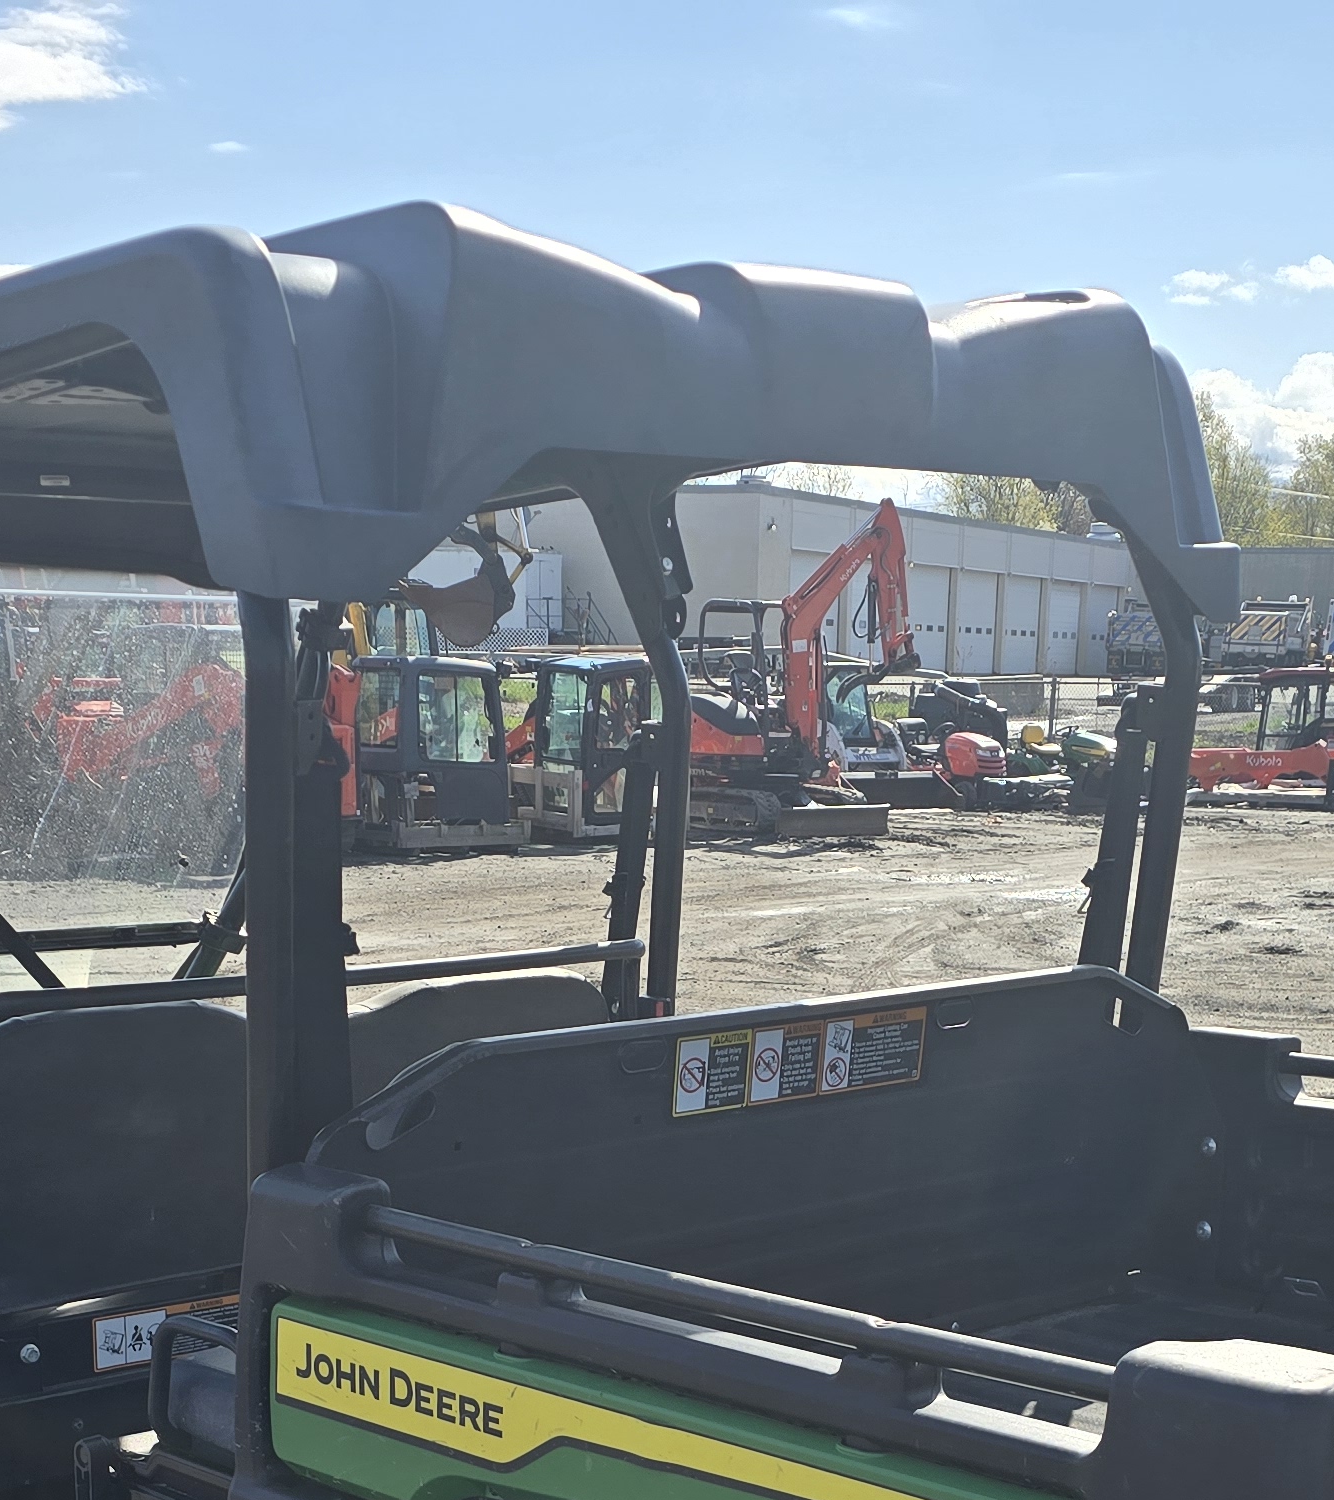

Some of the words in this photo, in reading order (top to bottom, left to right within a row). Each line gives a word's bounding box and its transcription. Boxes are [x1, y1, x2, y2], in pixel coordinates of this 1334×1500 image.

[839, 558, 861, 582] Kubota
[1246, 755, 1282, 767] Kubota
[720, 1032, 748, 1044] CAUTION
[196, 1298, 224, 1309] WARNING
[296, 1343, 380, 1400] JOHN
[389, 1367, 504, 1438] DEERE
